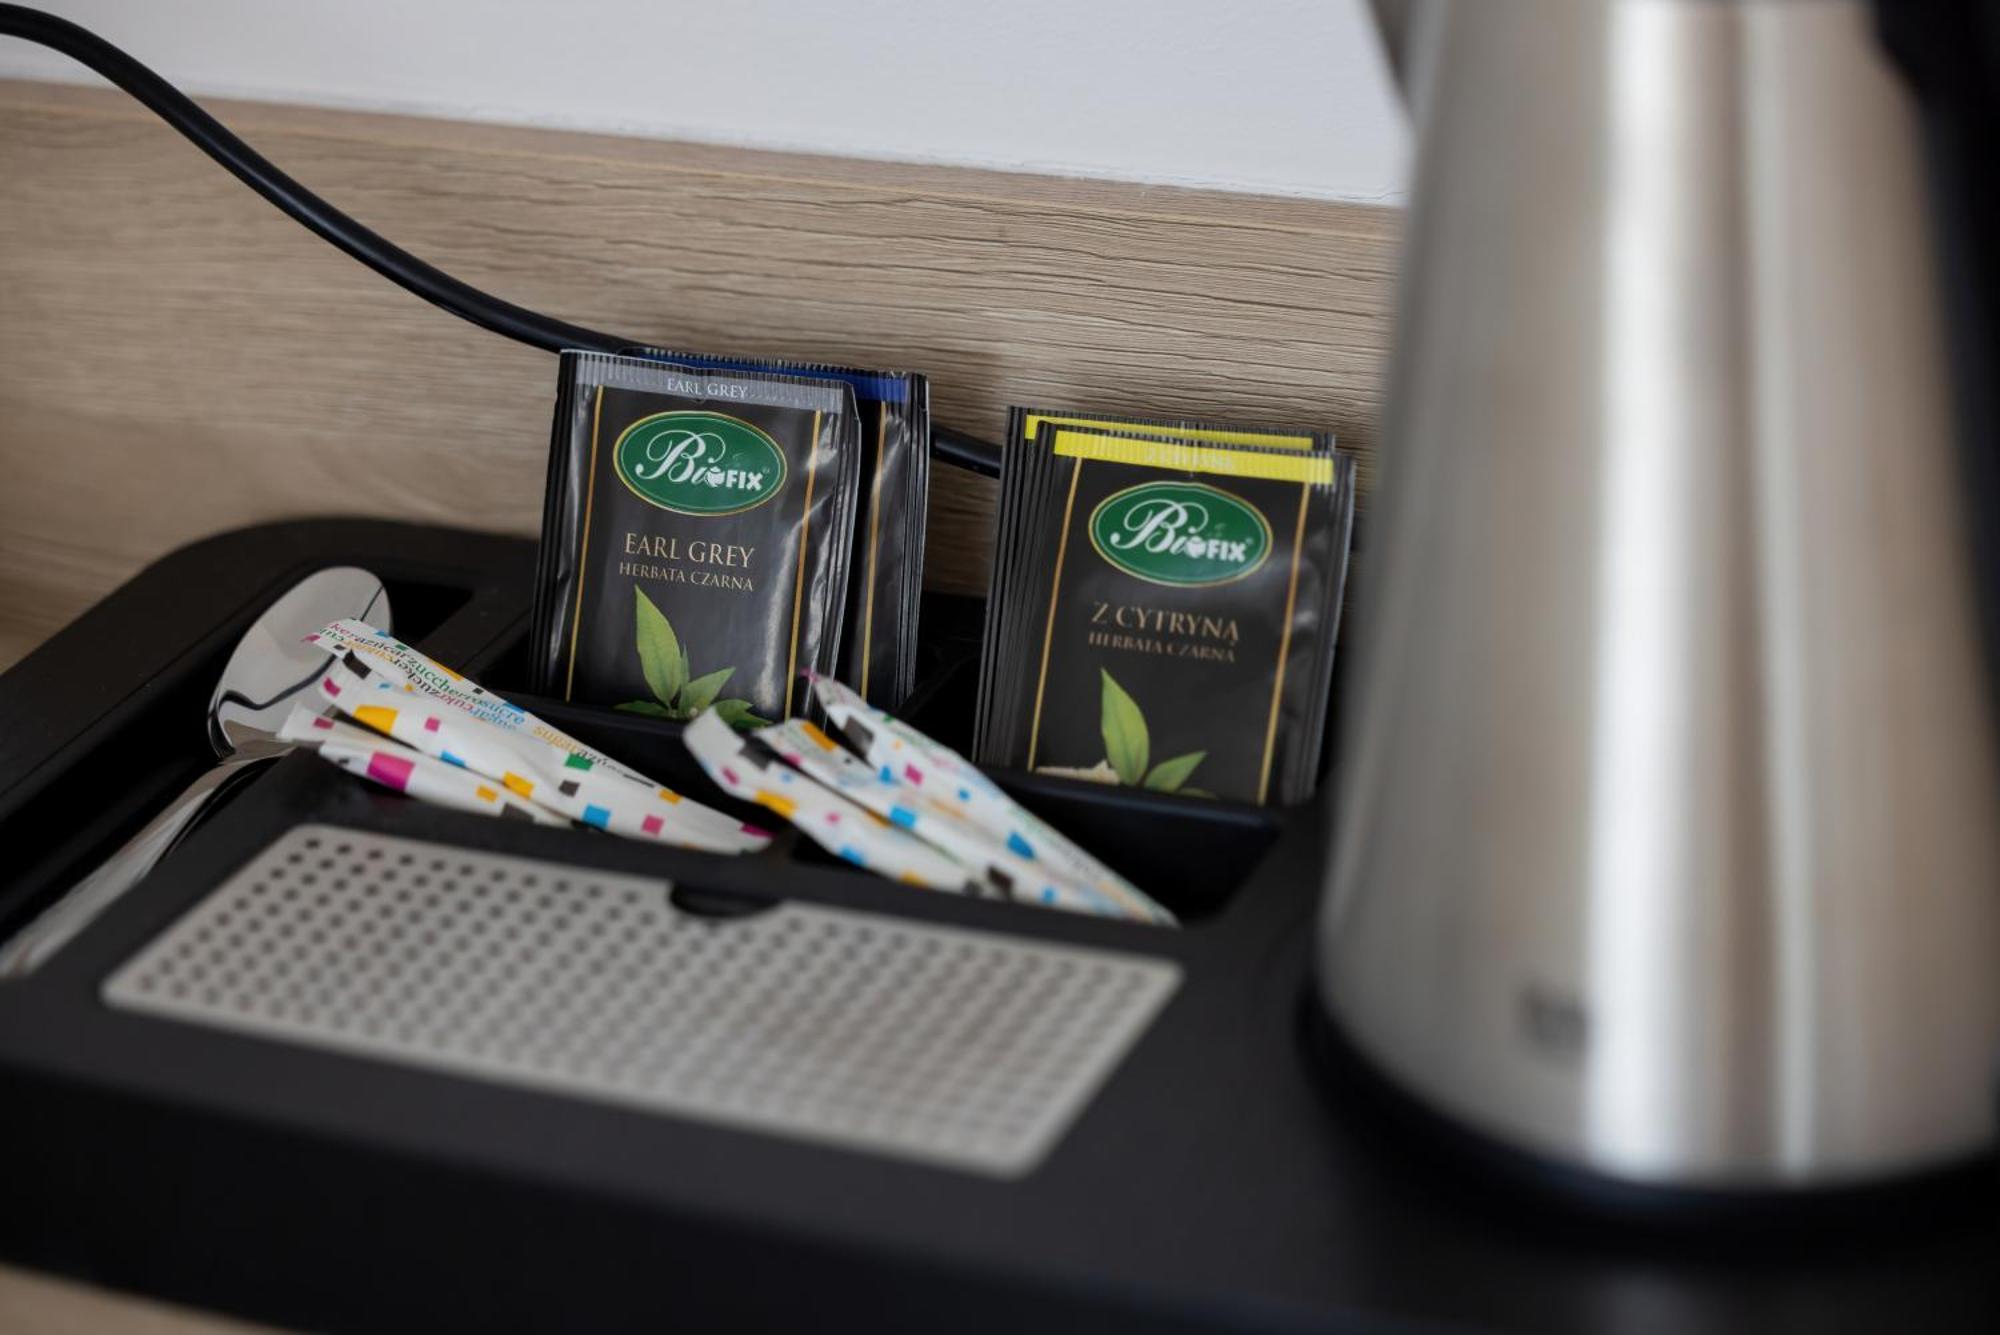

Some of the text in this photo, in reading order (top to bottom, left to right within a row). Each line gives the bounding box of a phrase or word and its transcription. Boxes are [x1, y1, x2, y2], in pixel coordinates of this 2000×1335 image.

[667, 378, 749, 399] EARL GREY
[625, 532, 755, 569] EARL GREY
[619, 562, 754, 592] HERBATA CZARNA
[1091, 601, 1110, 624] Z
[1089, 631, 1236, 663] HERBATA CZARNA
